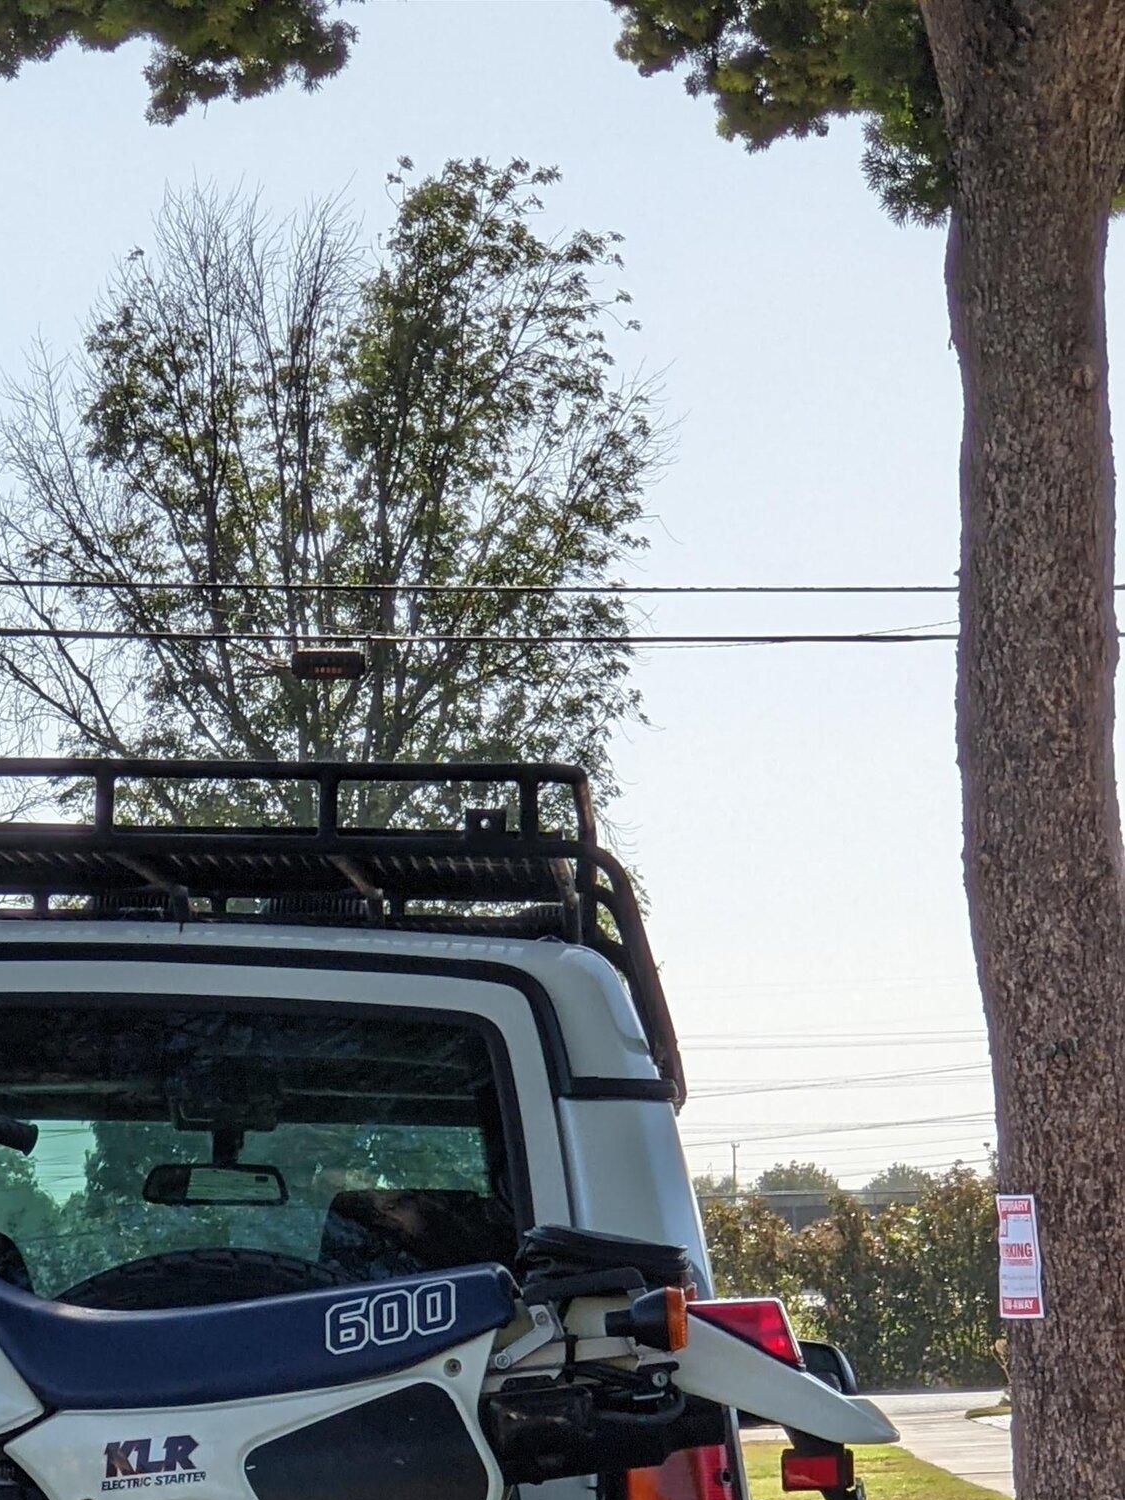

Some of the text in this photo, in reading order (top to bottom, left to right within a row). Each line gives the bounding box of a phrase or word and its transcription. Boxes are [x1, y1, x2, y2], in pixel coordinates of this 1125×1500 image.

[325, 1280, 456, 1355] 600
[104, 1435, 199, 1478] KLR
[101, 1471, 206, 1491] ELECTRIC STARTER
